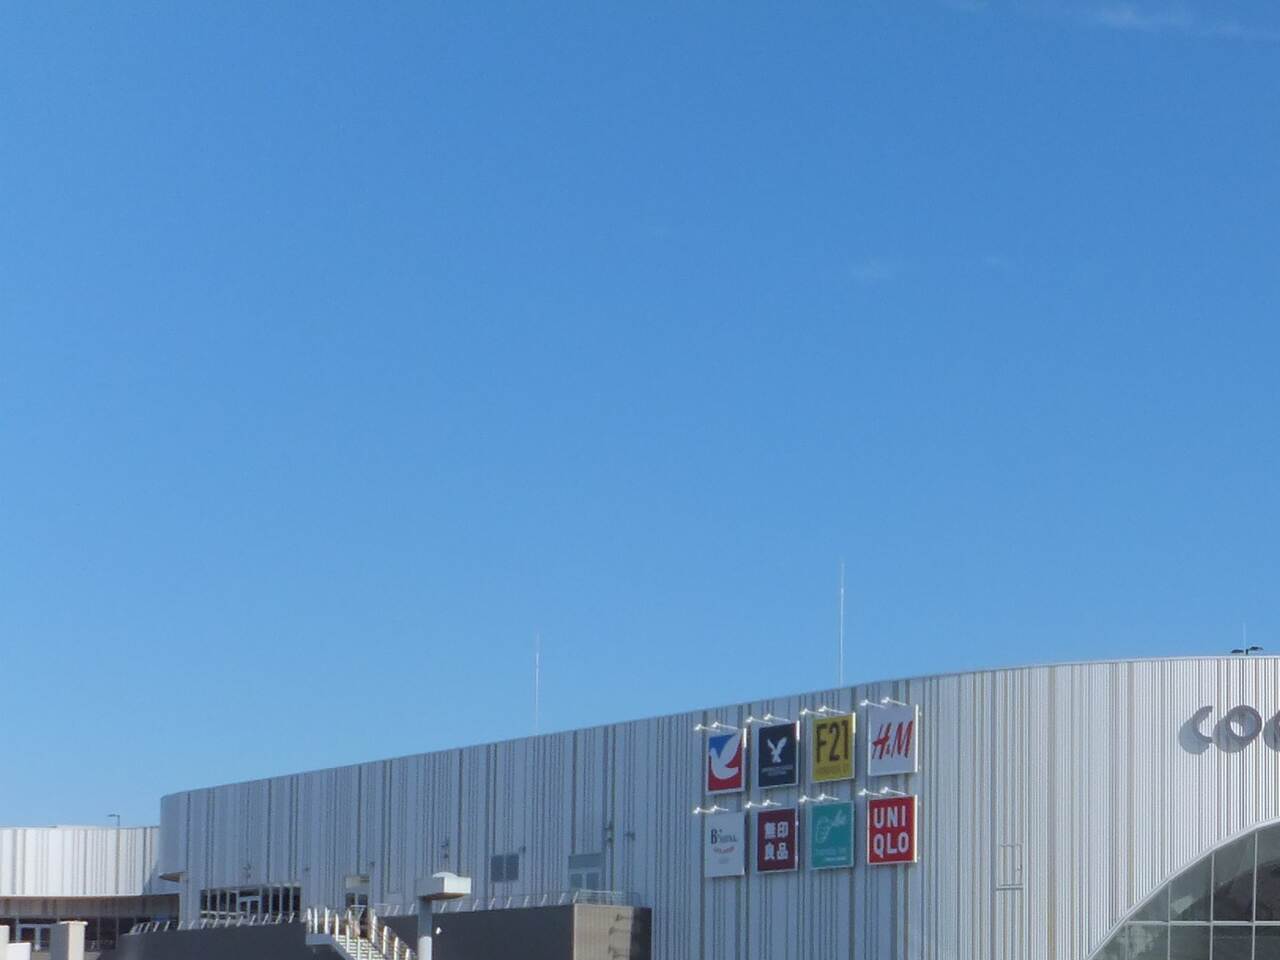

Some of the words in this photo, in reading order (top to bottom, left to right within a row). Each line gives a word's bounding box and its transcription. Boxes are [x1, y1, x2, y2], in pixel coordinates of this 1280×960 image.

[816, 720, 849, 763] F21
[872, 720, 914, 760] H&M
[873, 805, 907, 829] UNI
[873, 831, 910, 858] QLO
